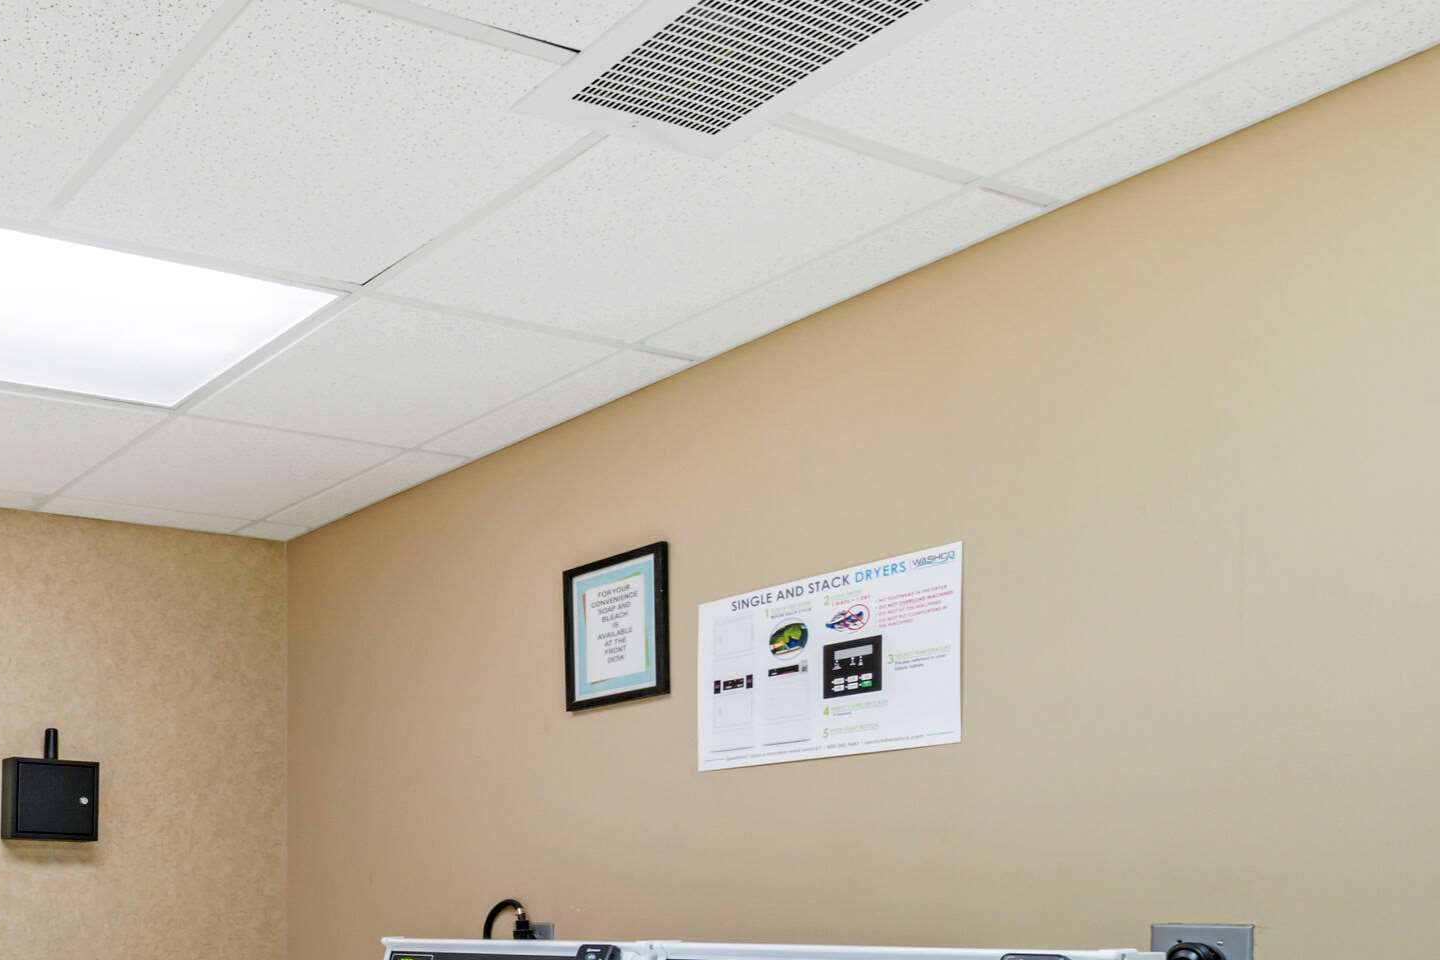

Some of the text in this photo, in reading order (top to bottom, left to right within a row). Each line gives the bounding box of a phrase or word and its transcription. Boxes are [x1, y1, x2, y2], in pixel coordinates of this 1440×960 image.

[730, 591, 774, 613] SINGLE
[776, 585, 805, 602] AND
[807, 573, 851, 595] STACK
[855, 560, 907, 583] DRYERS
[887, 654, 895, 665] 3
[823, 704, 831, 717] 4
